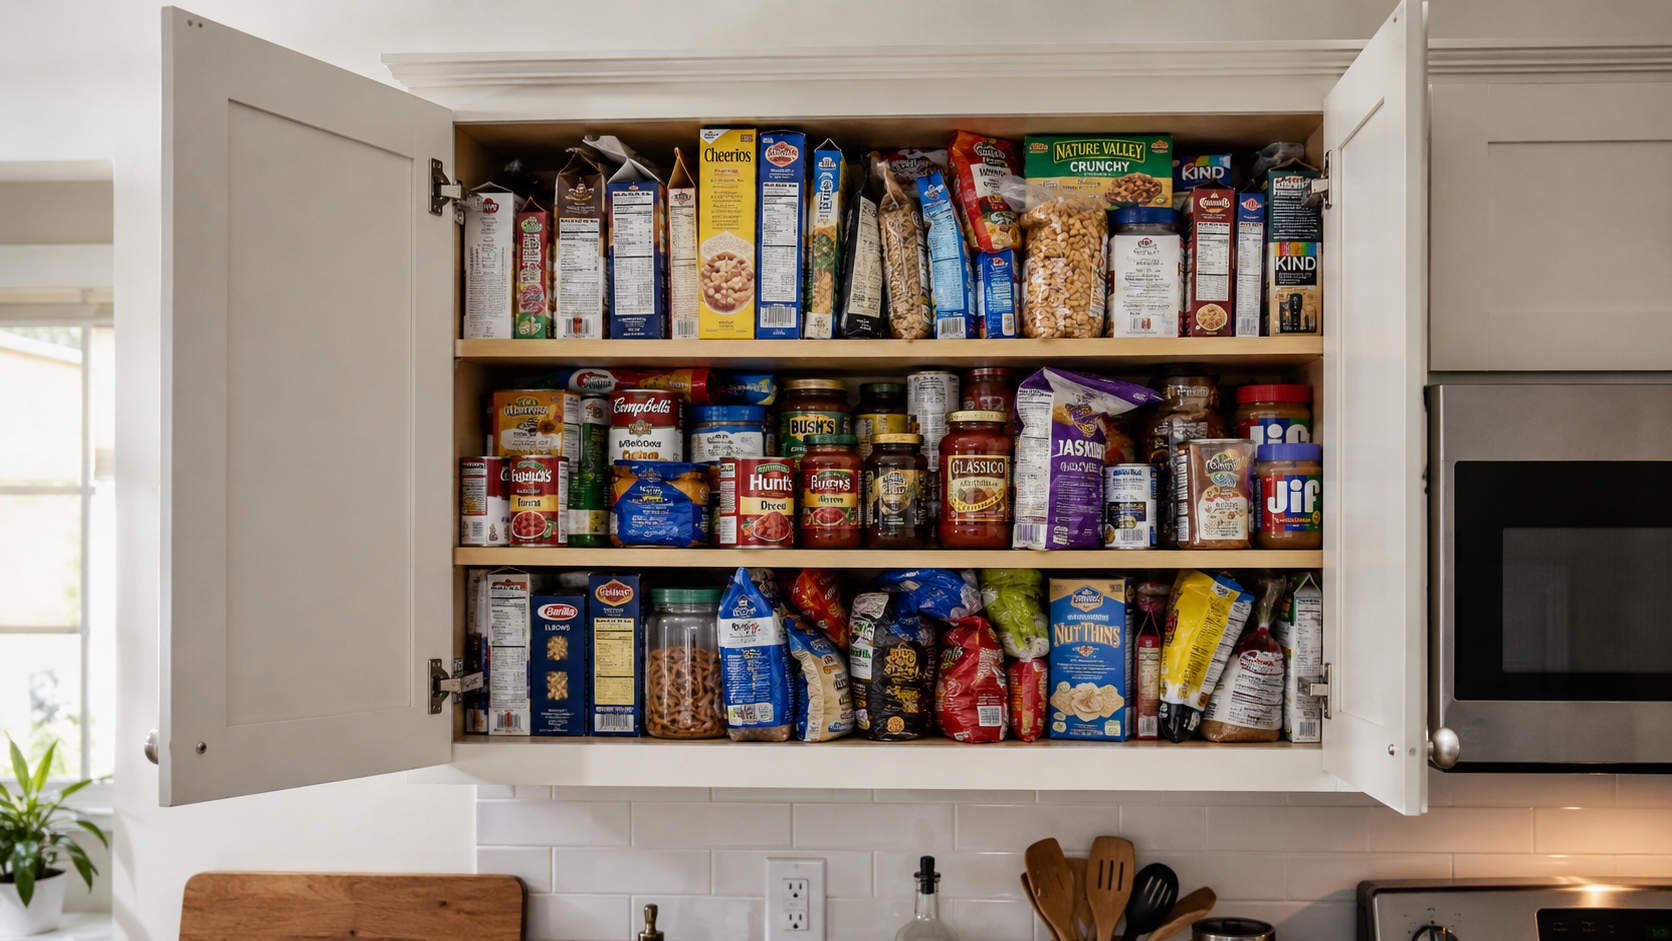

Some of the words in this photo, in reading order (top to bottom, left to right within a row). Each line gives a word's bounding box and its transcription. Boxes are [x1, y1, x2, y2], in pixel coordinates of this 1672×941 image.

[704, 147, 752, 163] Cheerios
[1055, 142, 1100, 160] NATURE
[1102, 141, 1144, 159] VALLEY
[1070, 161, 1130, 173] CRUNCHY
[1181, 163, 1225, 181] KIND
[1275, 256, 1317, 271] KIND
[952, 460, 1004, 474] CLASSICO
[749, 474, 793, 492] Hunt's
[1267, 478, 1320, 514] Jif
[1053, 622, 1081, 647] NUT
[1081, 622, 1121, 648] THINS
